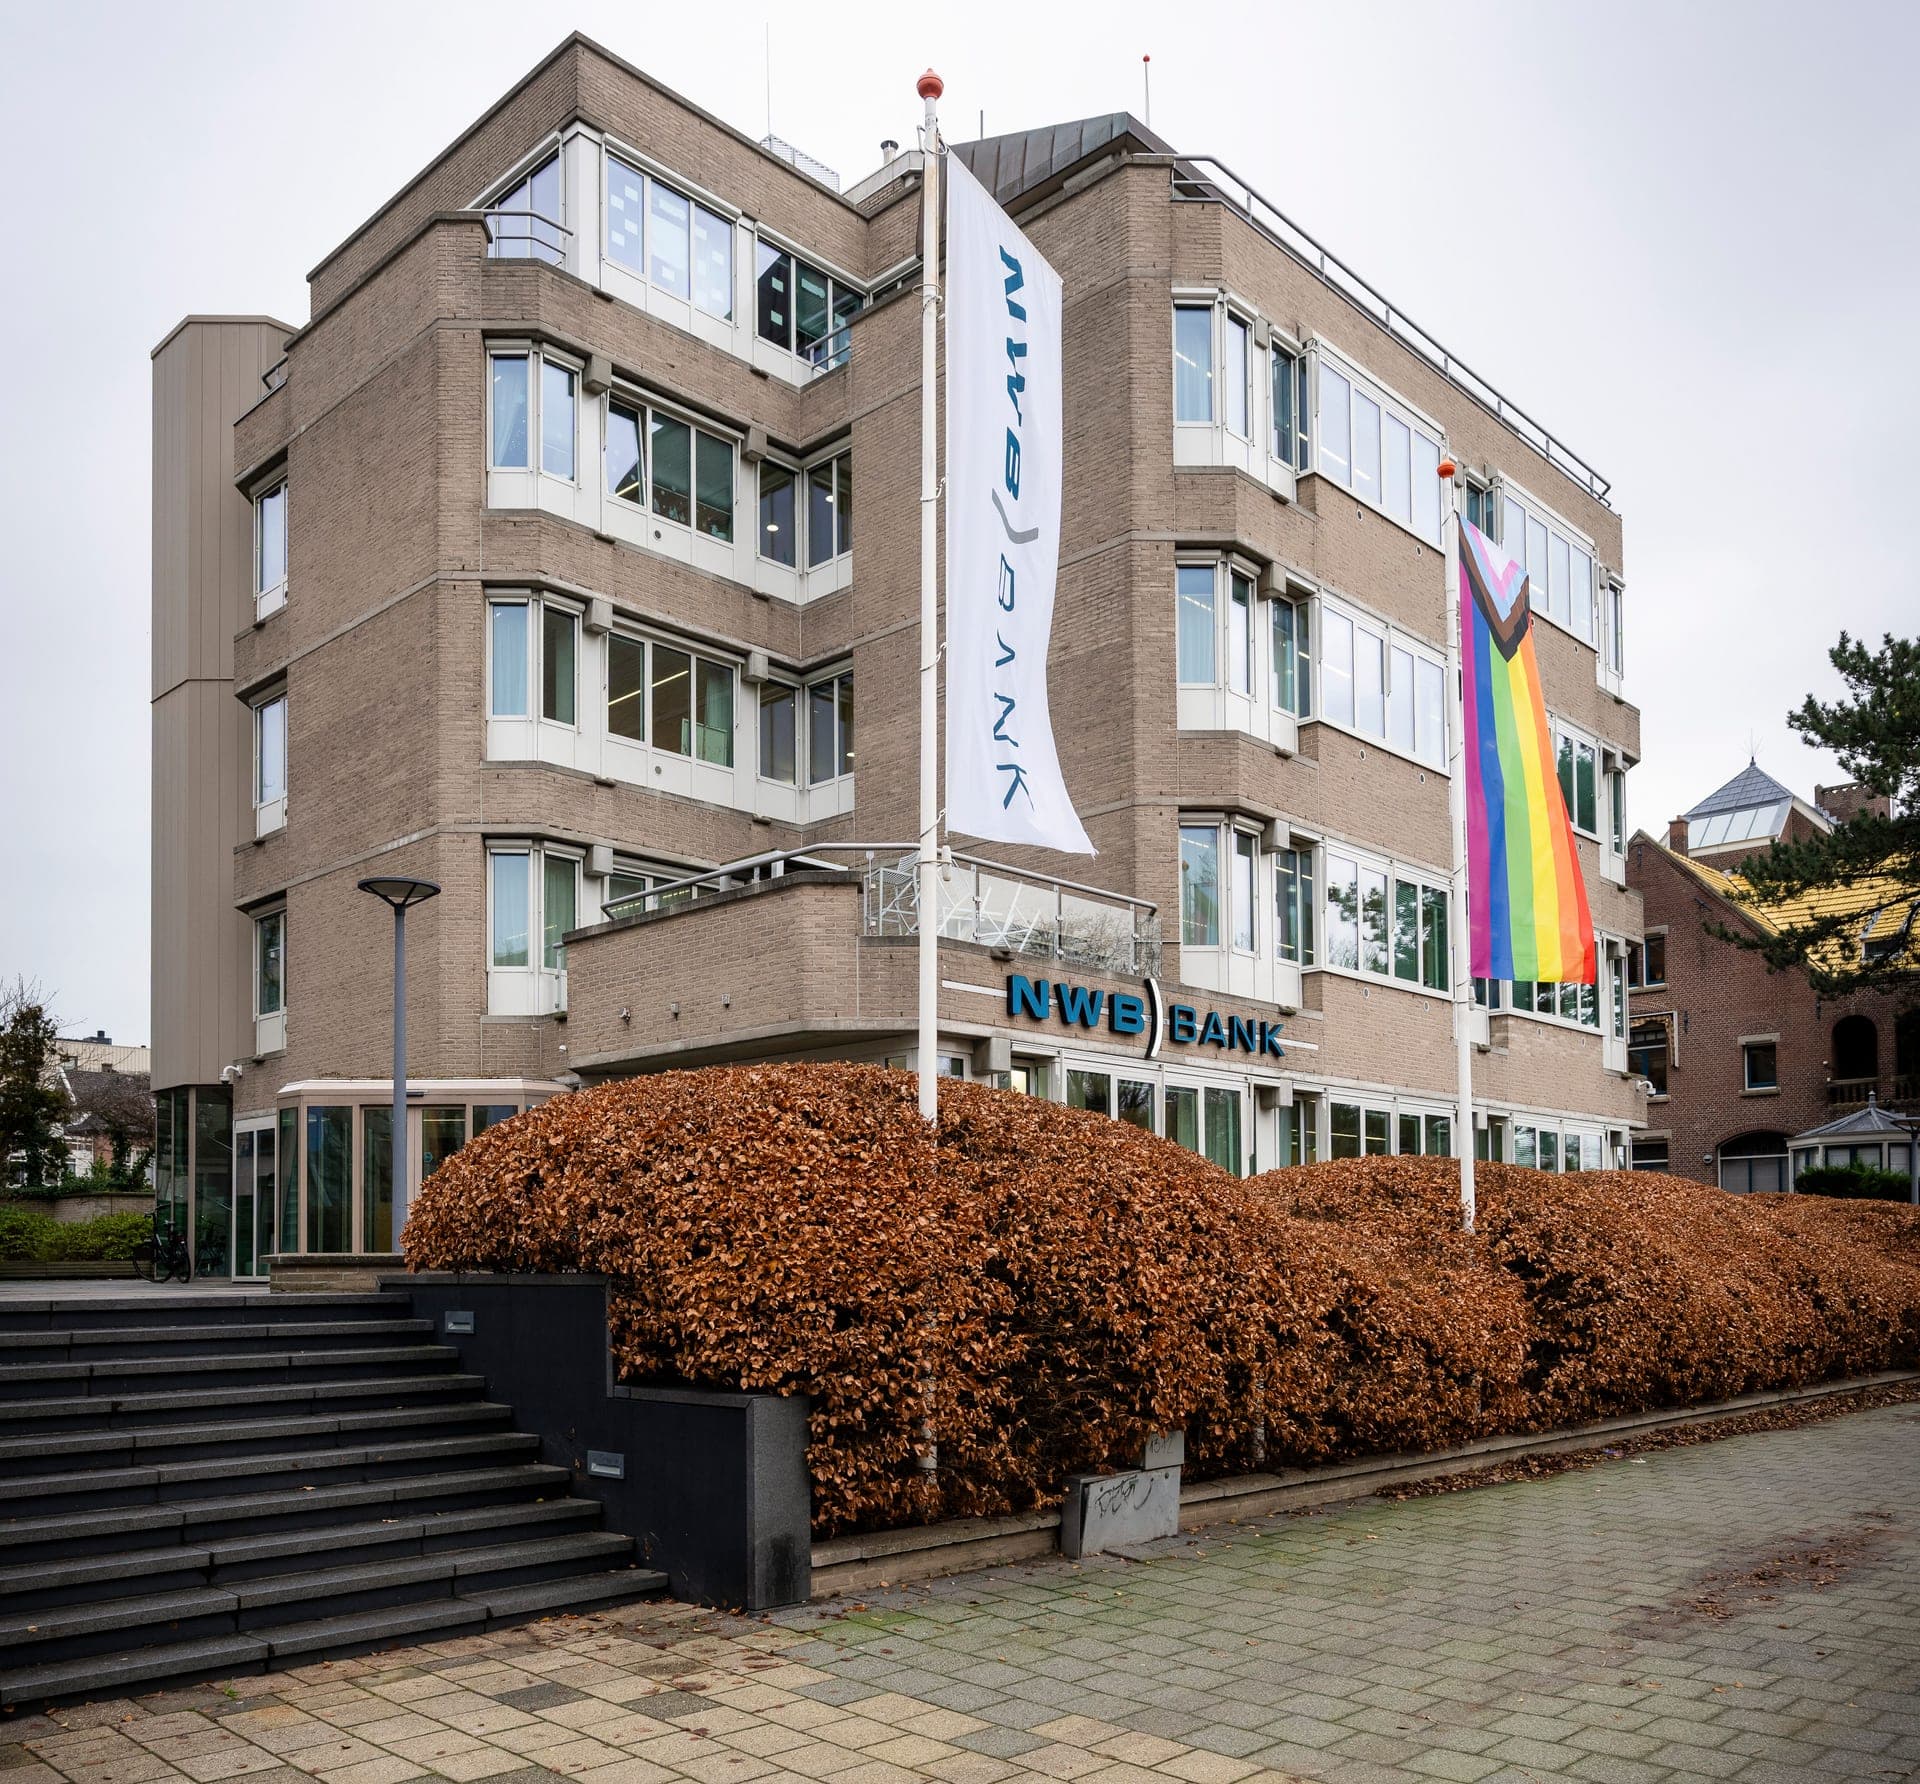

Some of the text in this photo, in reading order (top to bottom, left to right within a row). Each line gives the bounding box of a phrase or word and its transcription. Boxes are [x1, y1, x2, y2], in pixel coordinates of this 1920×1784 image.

[993, 552, 1035, 812] BANK
[1006, 974, 1285, 1057] NWB BANK
